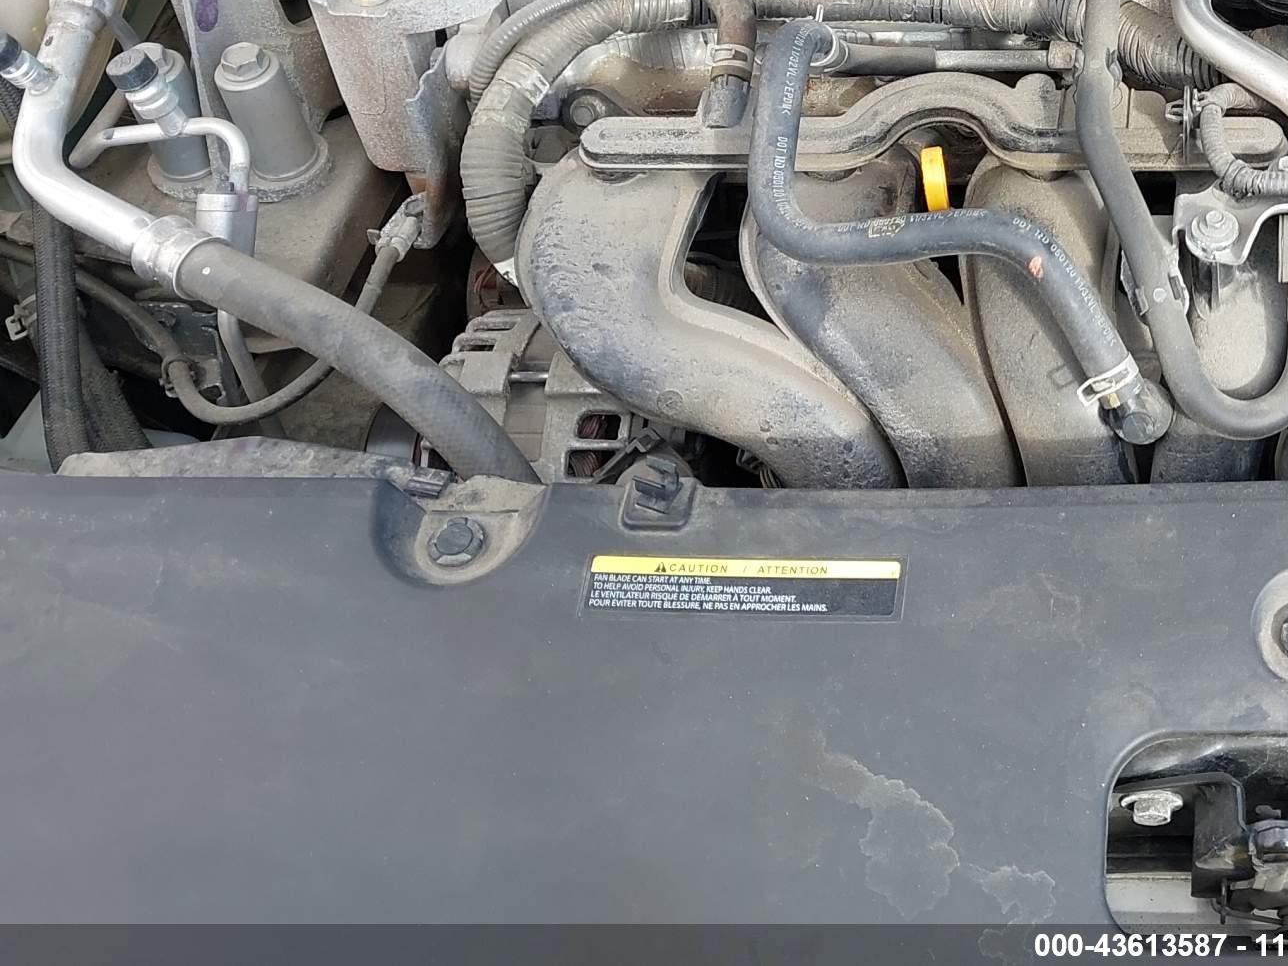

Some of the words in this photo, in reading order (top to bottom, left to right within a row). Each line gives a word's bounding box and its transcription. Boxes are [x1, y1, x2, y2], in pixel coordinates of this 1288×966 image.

[777, 136, 788, 153] DOT
[1012, 217, 1032, 230] DOT
[669, 563, 728, 573] CAUTION
[757, 566, 828, 574] ATTENTION
[644, 584, 680, 592] PERSONAL
[600, 591, 650, 599] VENTILATEUR
[650, 592, 678, 600] RISQUE
[589, 599, 610, 607] POUR
[740, 603, 787, 611] APPROCHER
